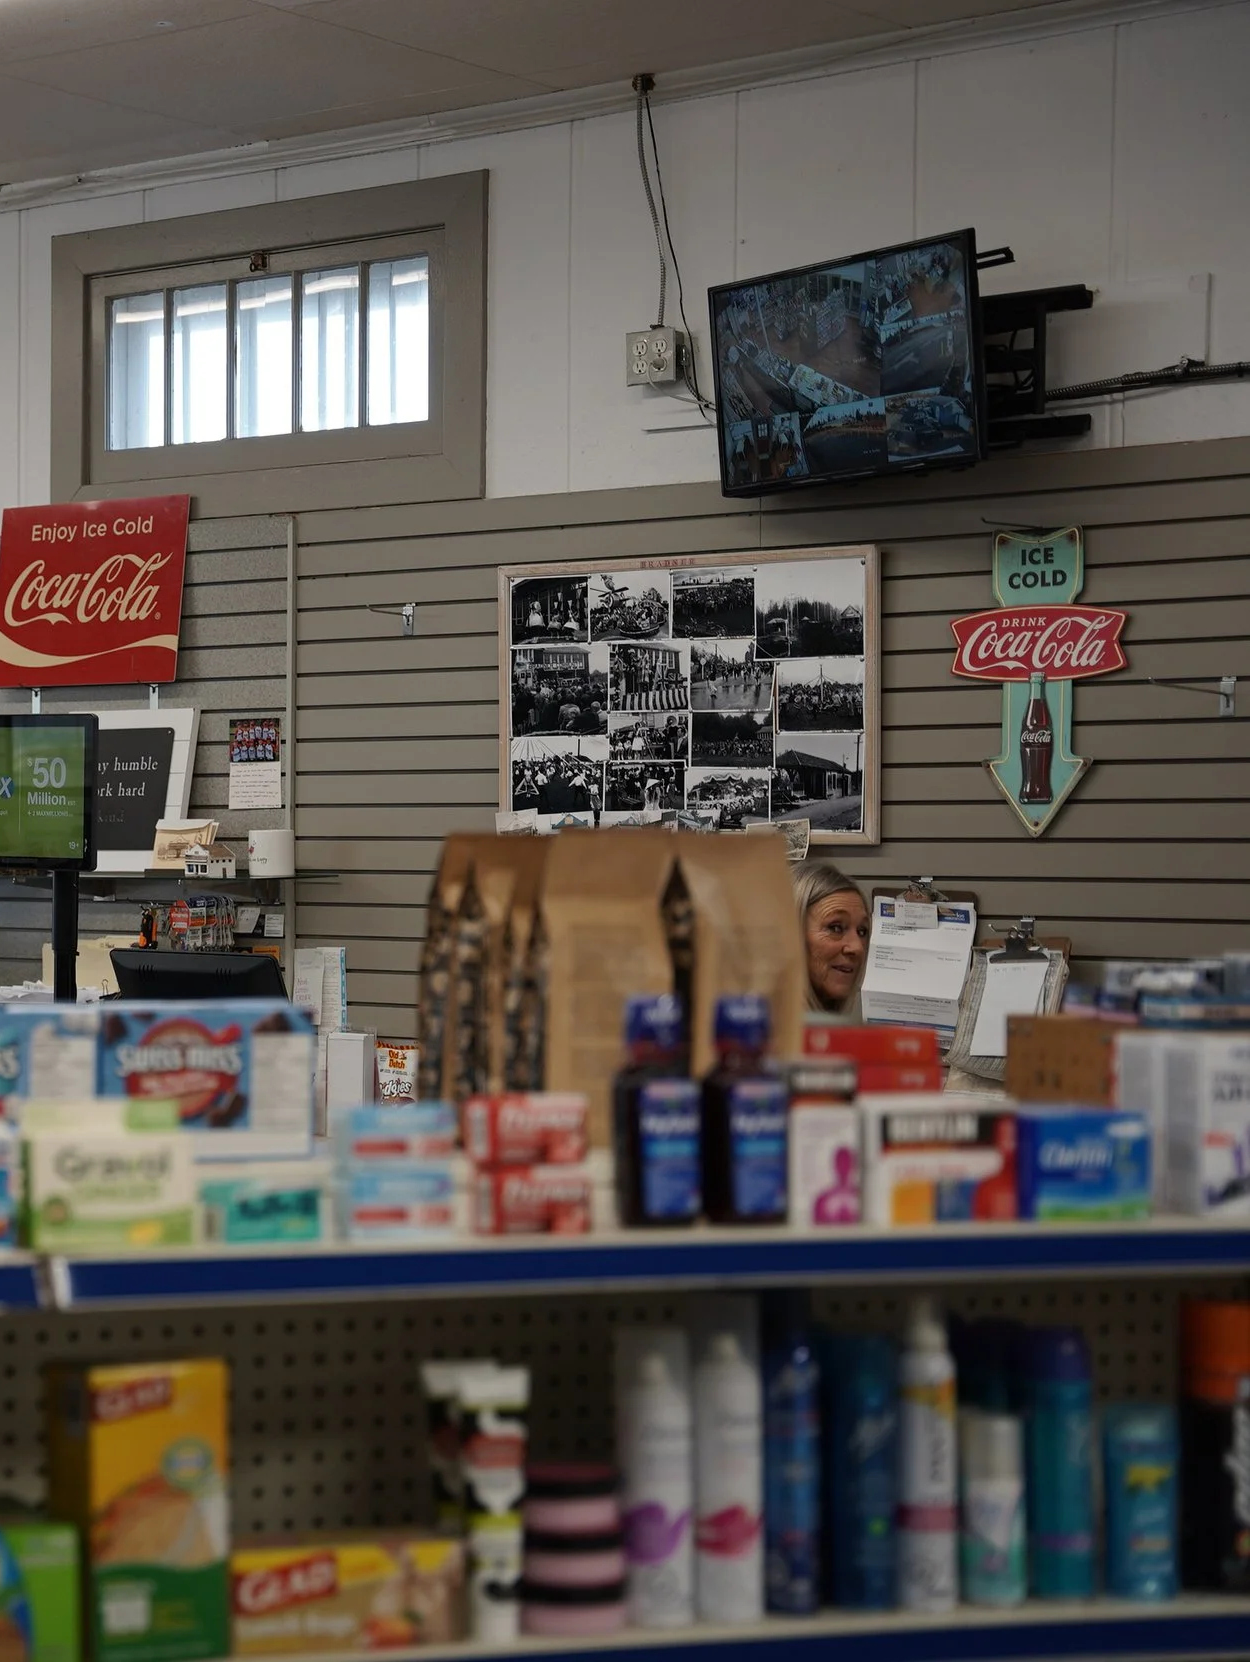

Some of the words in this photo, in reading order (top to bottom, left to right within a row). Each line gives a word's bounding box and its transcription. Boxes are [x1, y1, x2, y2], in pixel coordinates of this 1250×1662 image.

[32, 523, 77, 543] Enjoy
[83, 521, 107, 537] Ice
[113, 516, 153, 536] Cold
[1021, 548, 1054, 565] ICE
[1008, 569, 1067, 589] COLD
[4, 552, 173, 627] Coca-Cola
[1002, 616, 1046, 627] DRINK
[962, 615, 1115, 671] Coca-Cola
[1020, 729, 1052, 744] Coca-Cola
[114, 756, 158, 771] humble
[118, 781, 146, 797] hard
[27, 792, 66, 806] Million
[388, 1050, 399, 1059] Old
[388, 1059, 406, 1069] Dutch
[235, 1559, 336, 1611] GLAD
